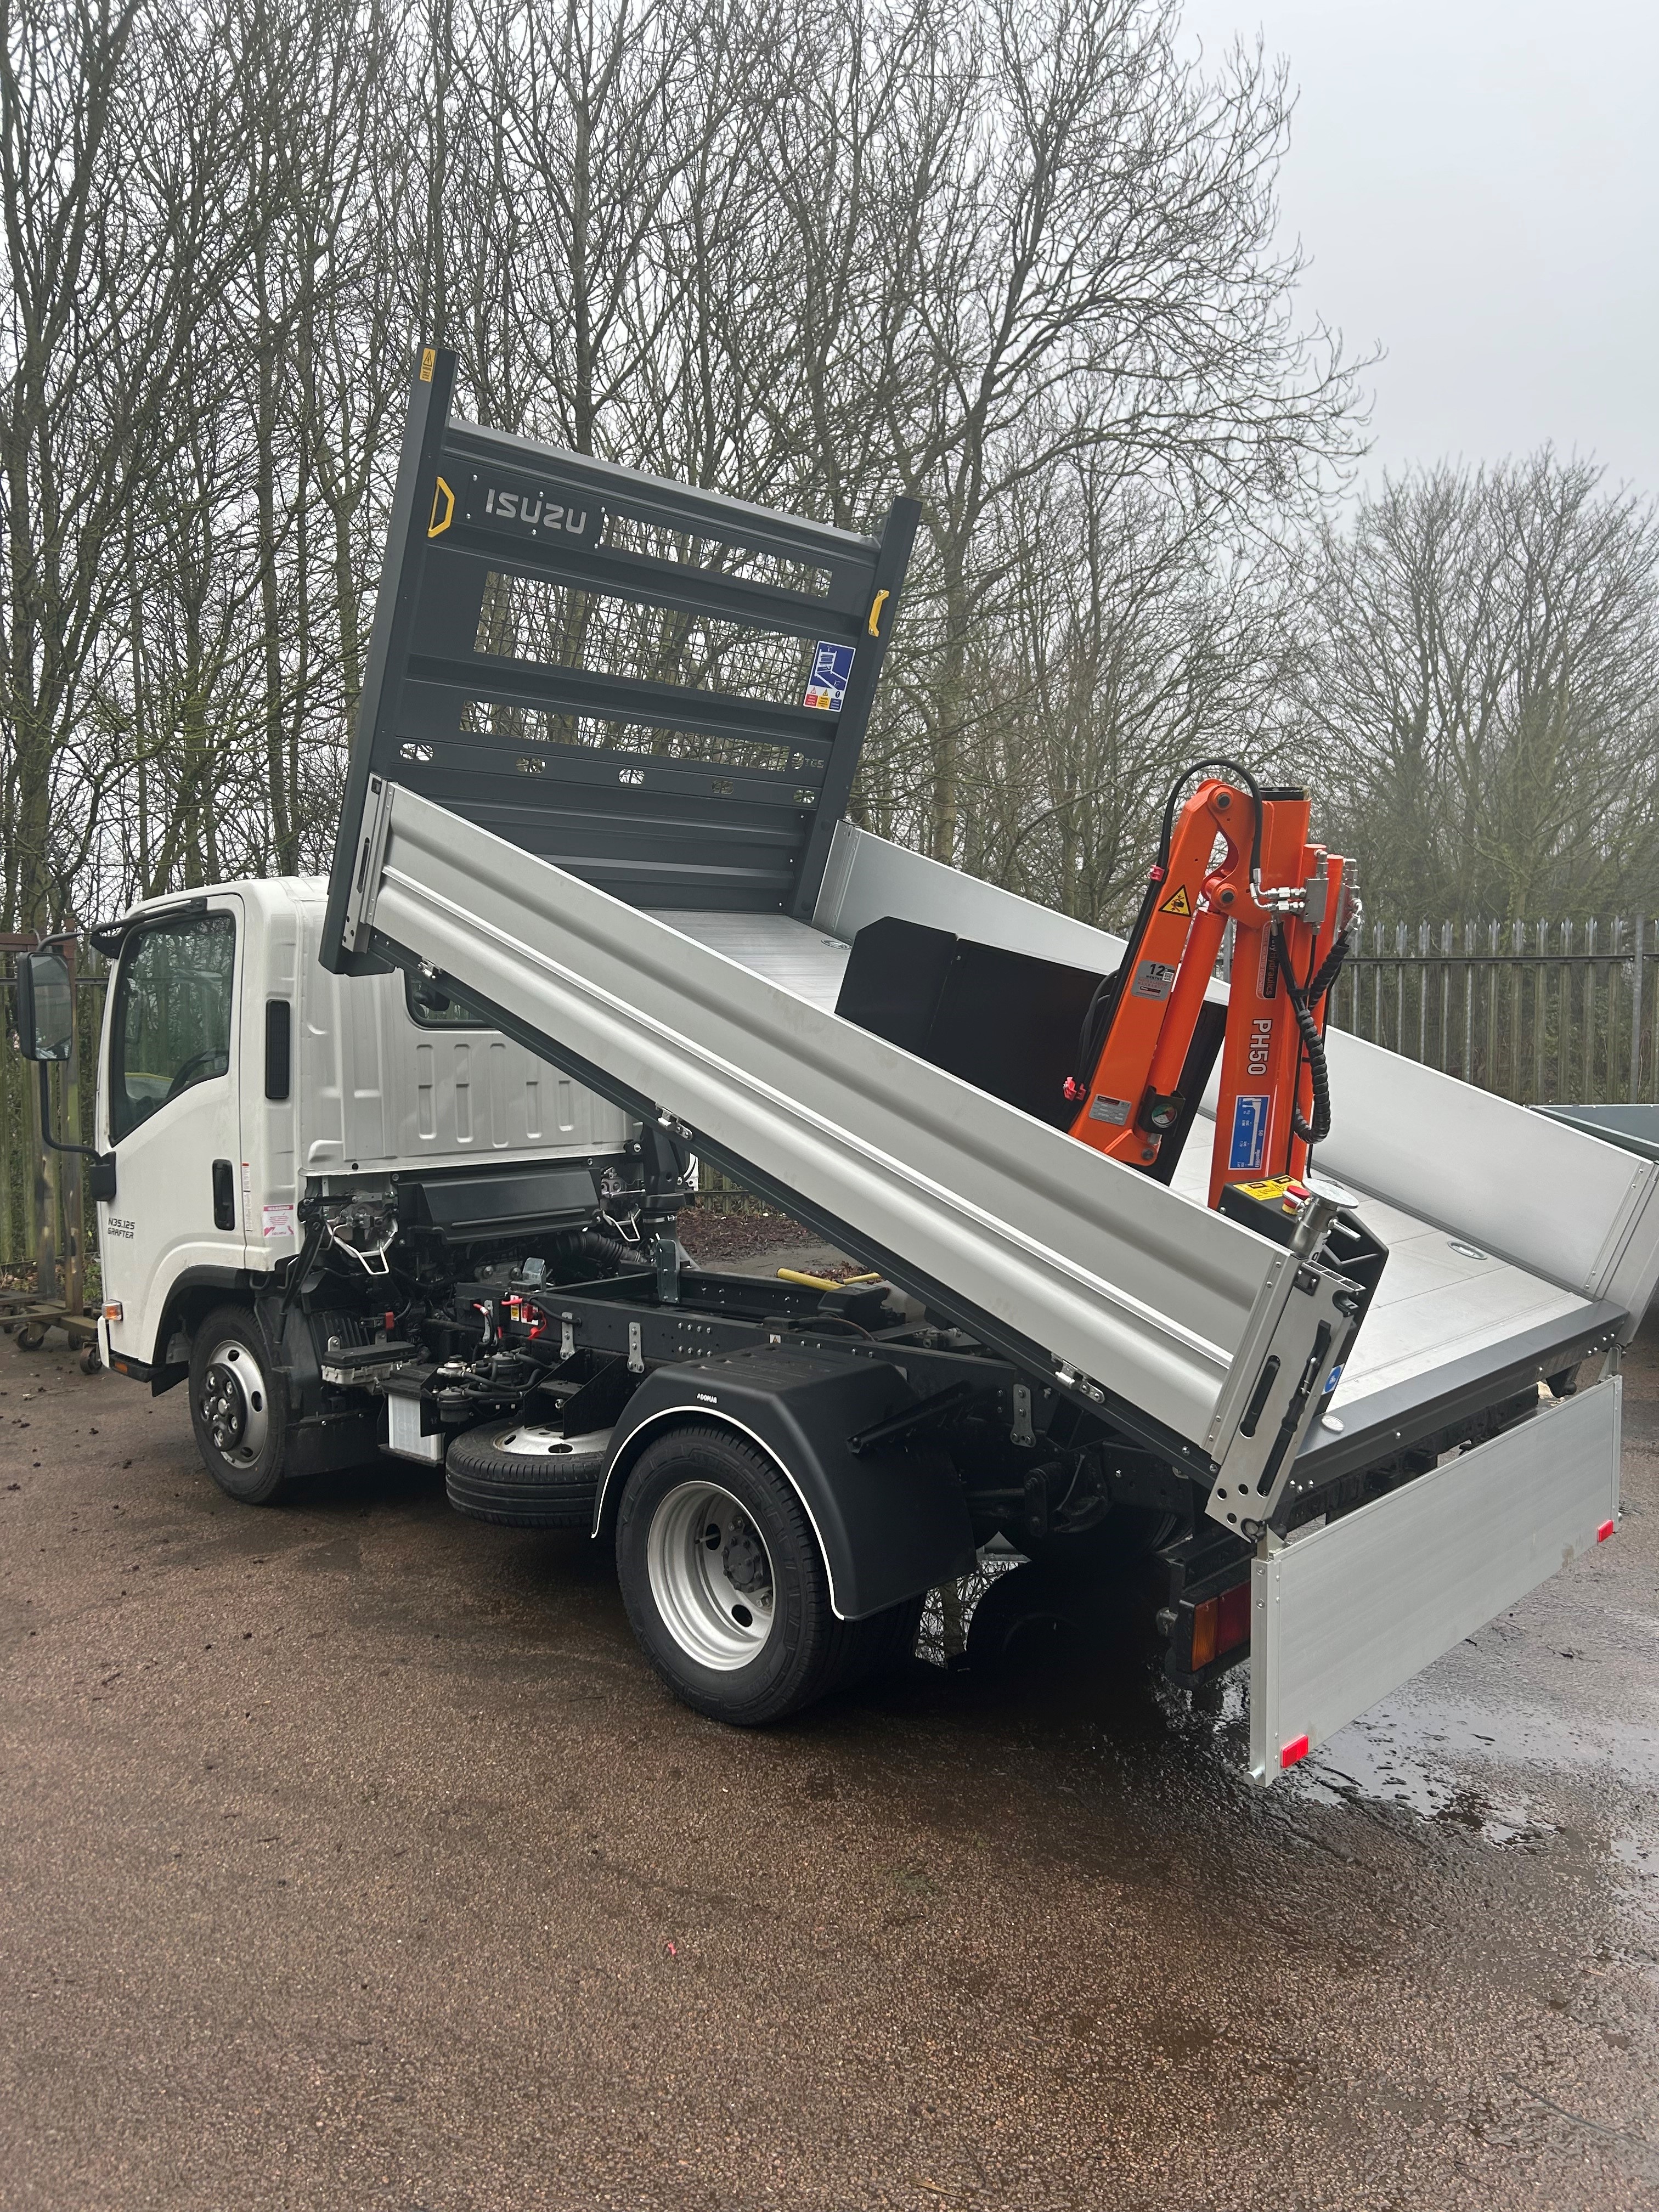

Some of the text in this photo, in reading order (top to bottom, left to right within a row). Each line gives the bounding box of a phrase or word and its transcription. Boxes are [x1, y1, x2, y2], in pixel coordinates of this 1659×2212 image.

[486, 488, 587, 534] ISUZU
[1150, 963, 1165, 977] 12
[1247, 1019, 1272, 1075] PH50
[108, 1217, 135, 1230] N35.125
[108, 1227, 134, 1239] GRAFTER
